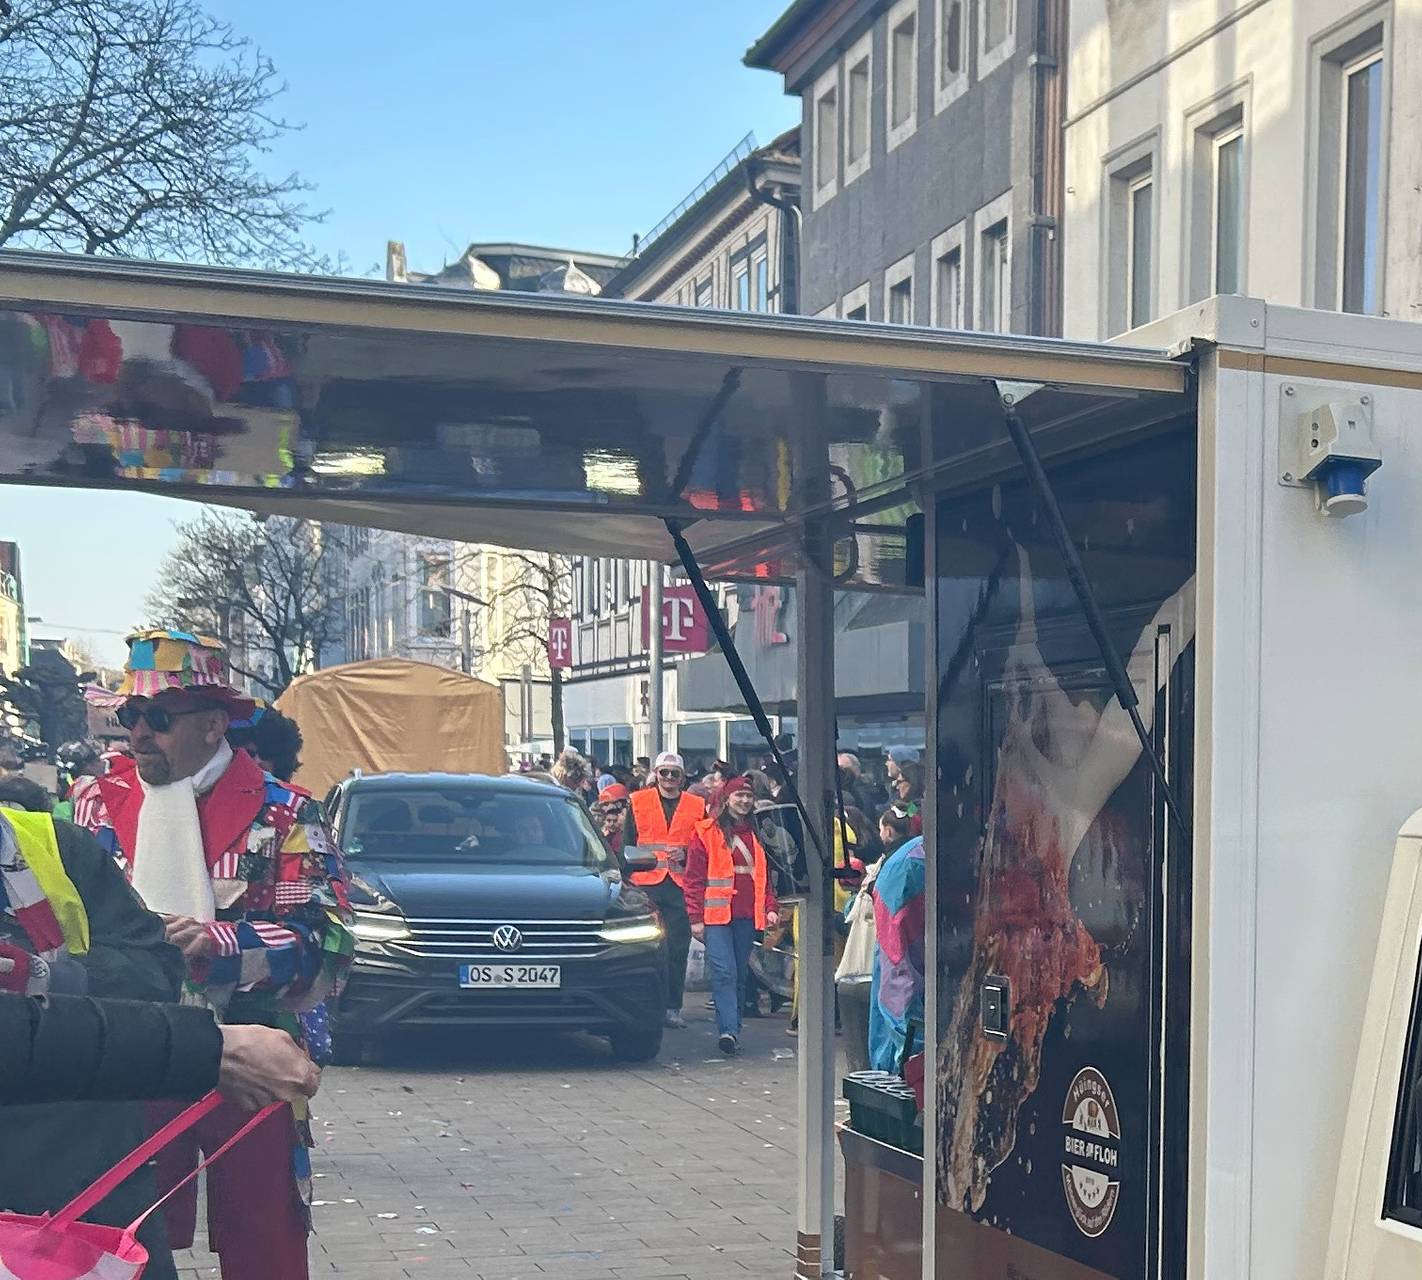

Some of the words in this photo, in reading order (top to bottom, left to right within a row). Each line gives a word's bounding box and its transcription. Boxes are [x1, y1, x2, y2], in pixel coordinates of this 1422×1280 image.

[552, 627, 568, 660] T
[470, 967, 492, 983] OS
[503, 967, 514, 983] S
[517, 967, 559, 983] 2047
[1093, 1144, 1118, 1168] FLOH
